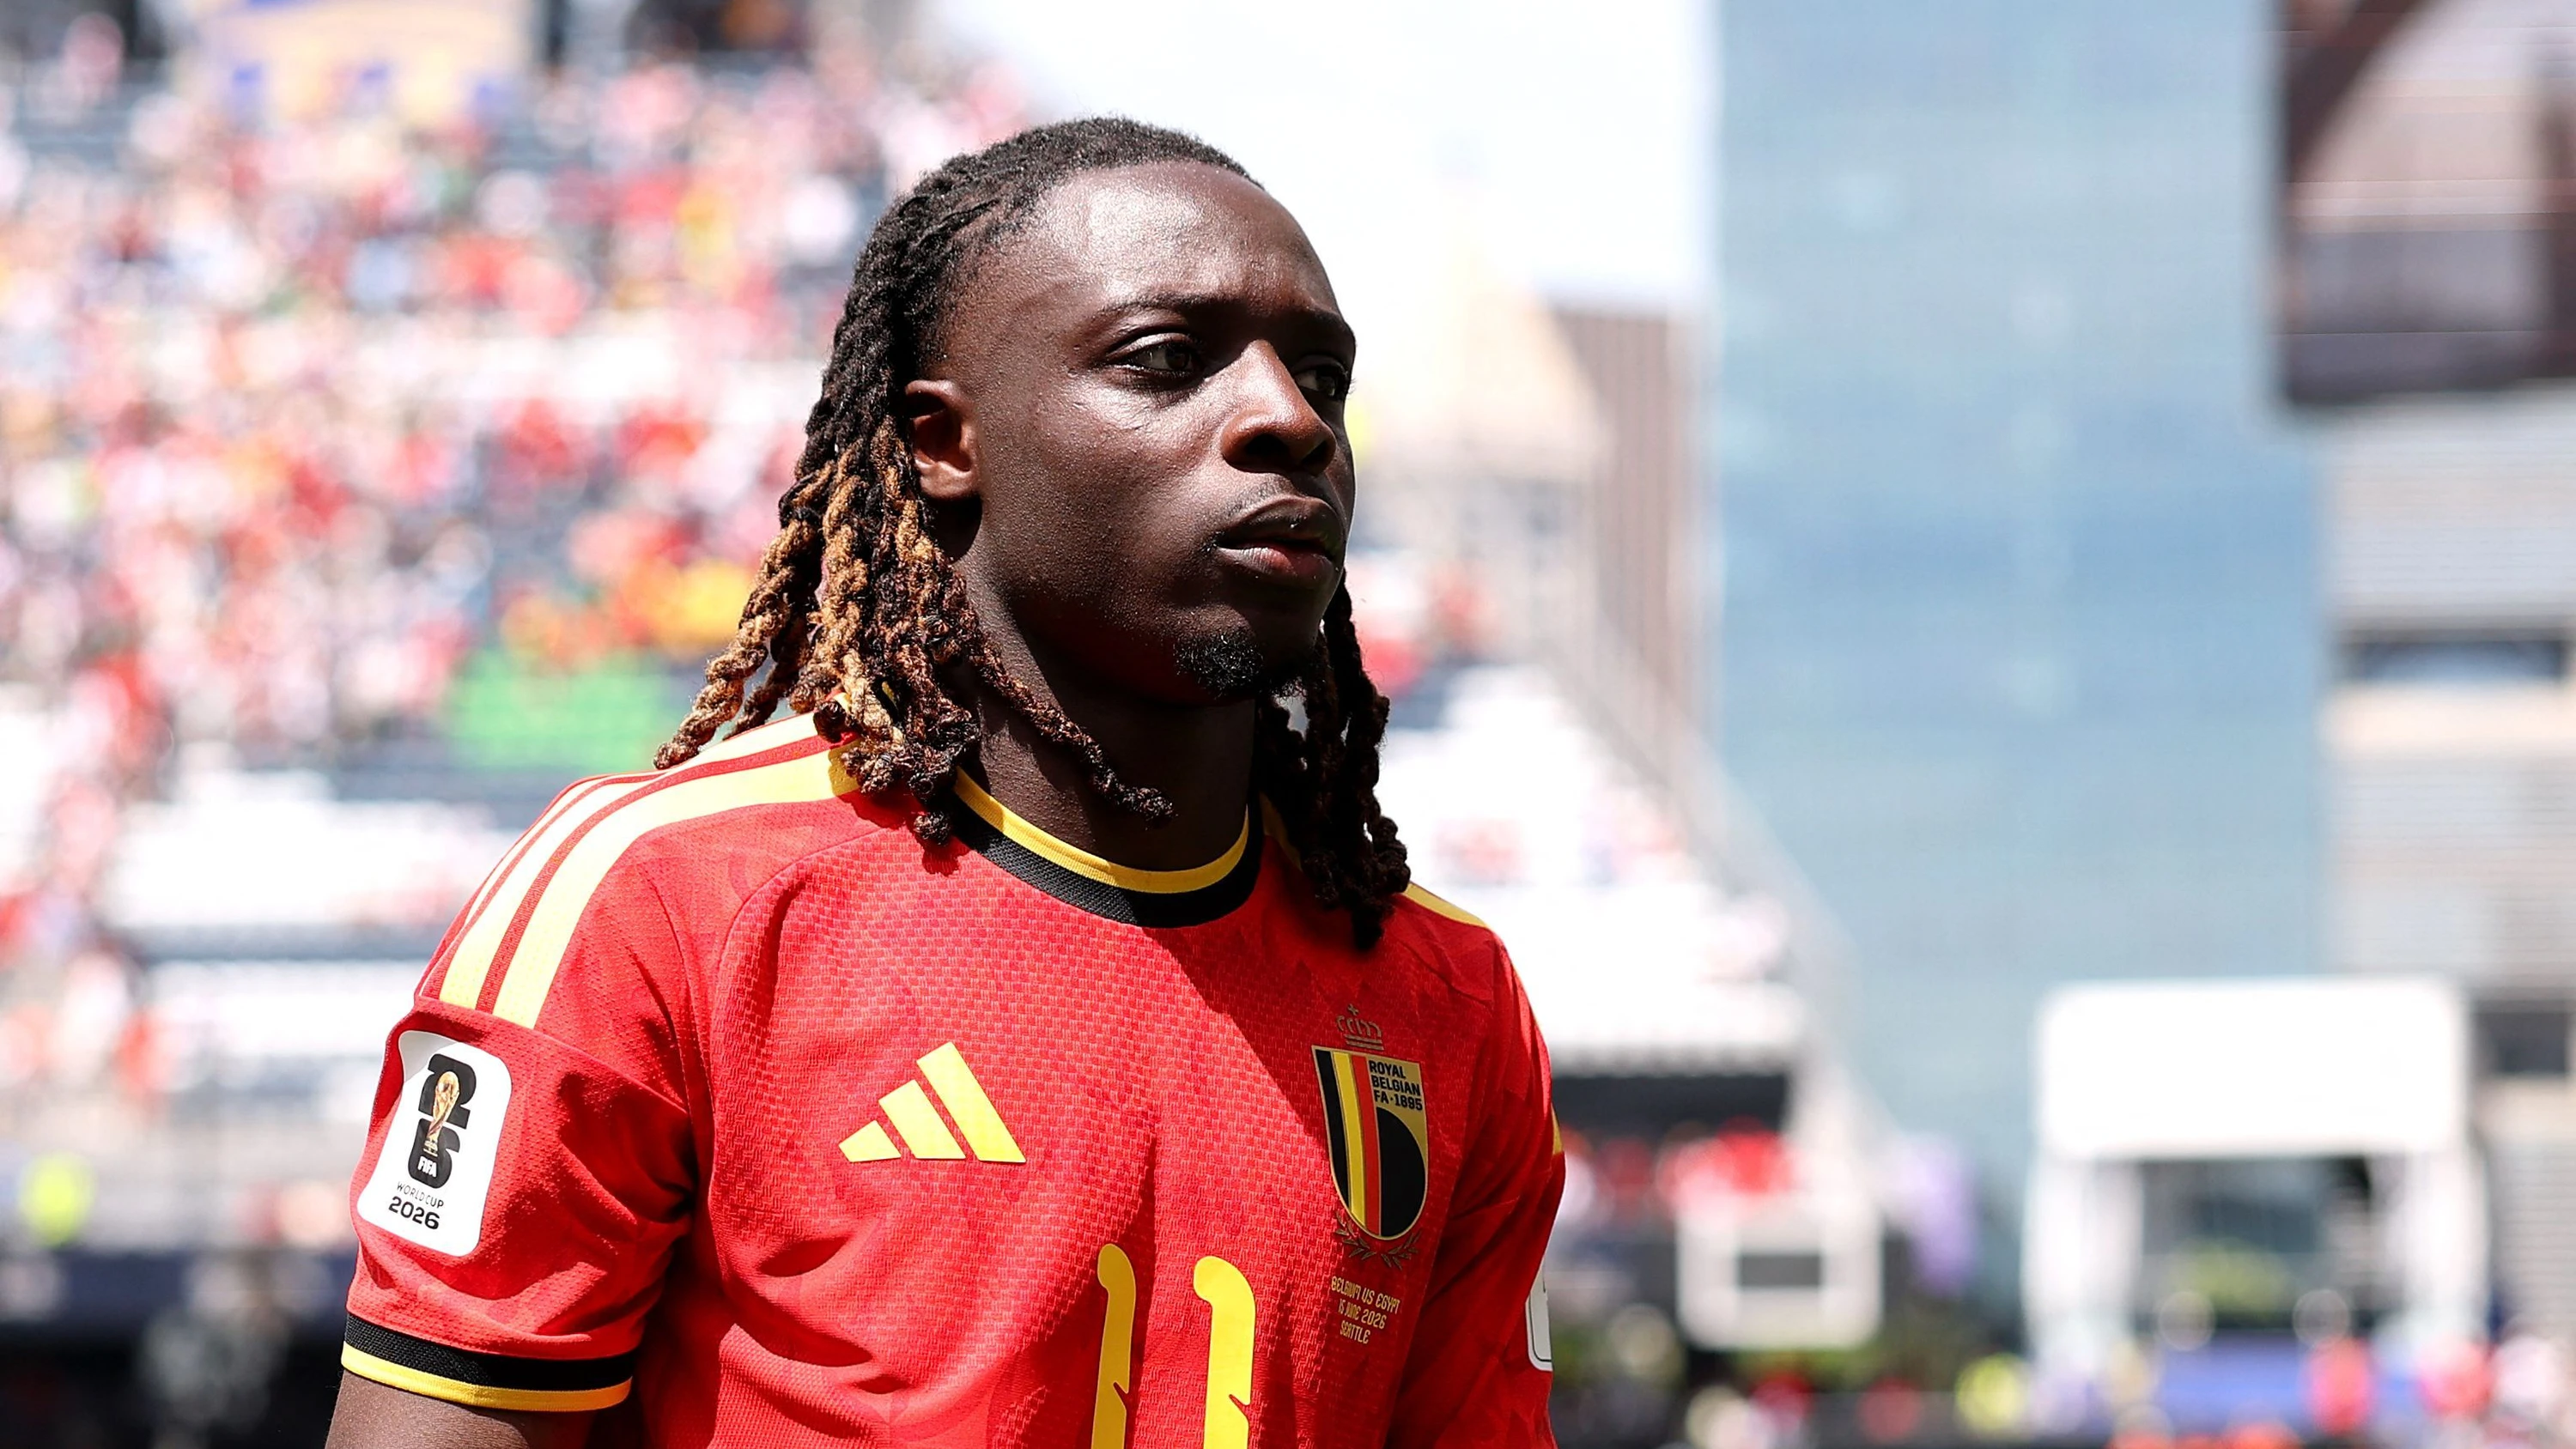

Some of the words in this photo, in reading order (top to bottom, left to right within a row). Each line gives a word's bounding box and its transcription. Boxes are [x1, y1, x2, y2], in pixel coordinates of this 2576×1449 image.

[1368, 1060, 1406, 1078] ROYAL
[1370, 1075, 1421, 1096] BELGIAN
[417, 1155, 438, 1178] FIFA
[388, 1196, 440, 1230] 2026
[1376, 1293, 1400, 1314] EGYPT
[1361, 1309, 1387, 1329] 2026
[1340, 1320, 1370, 1344] SEATTLE
